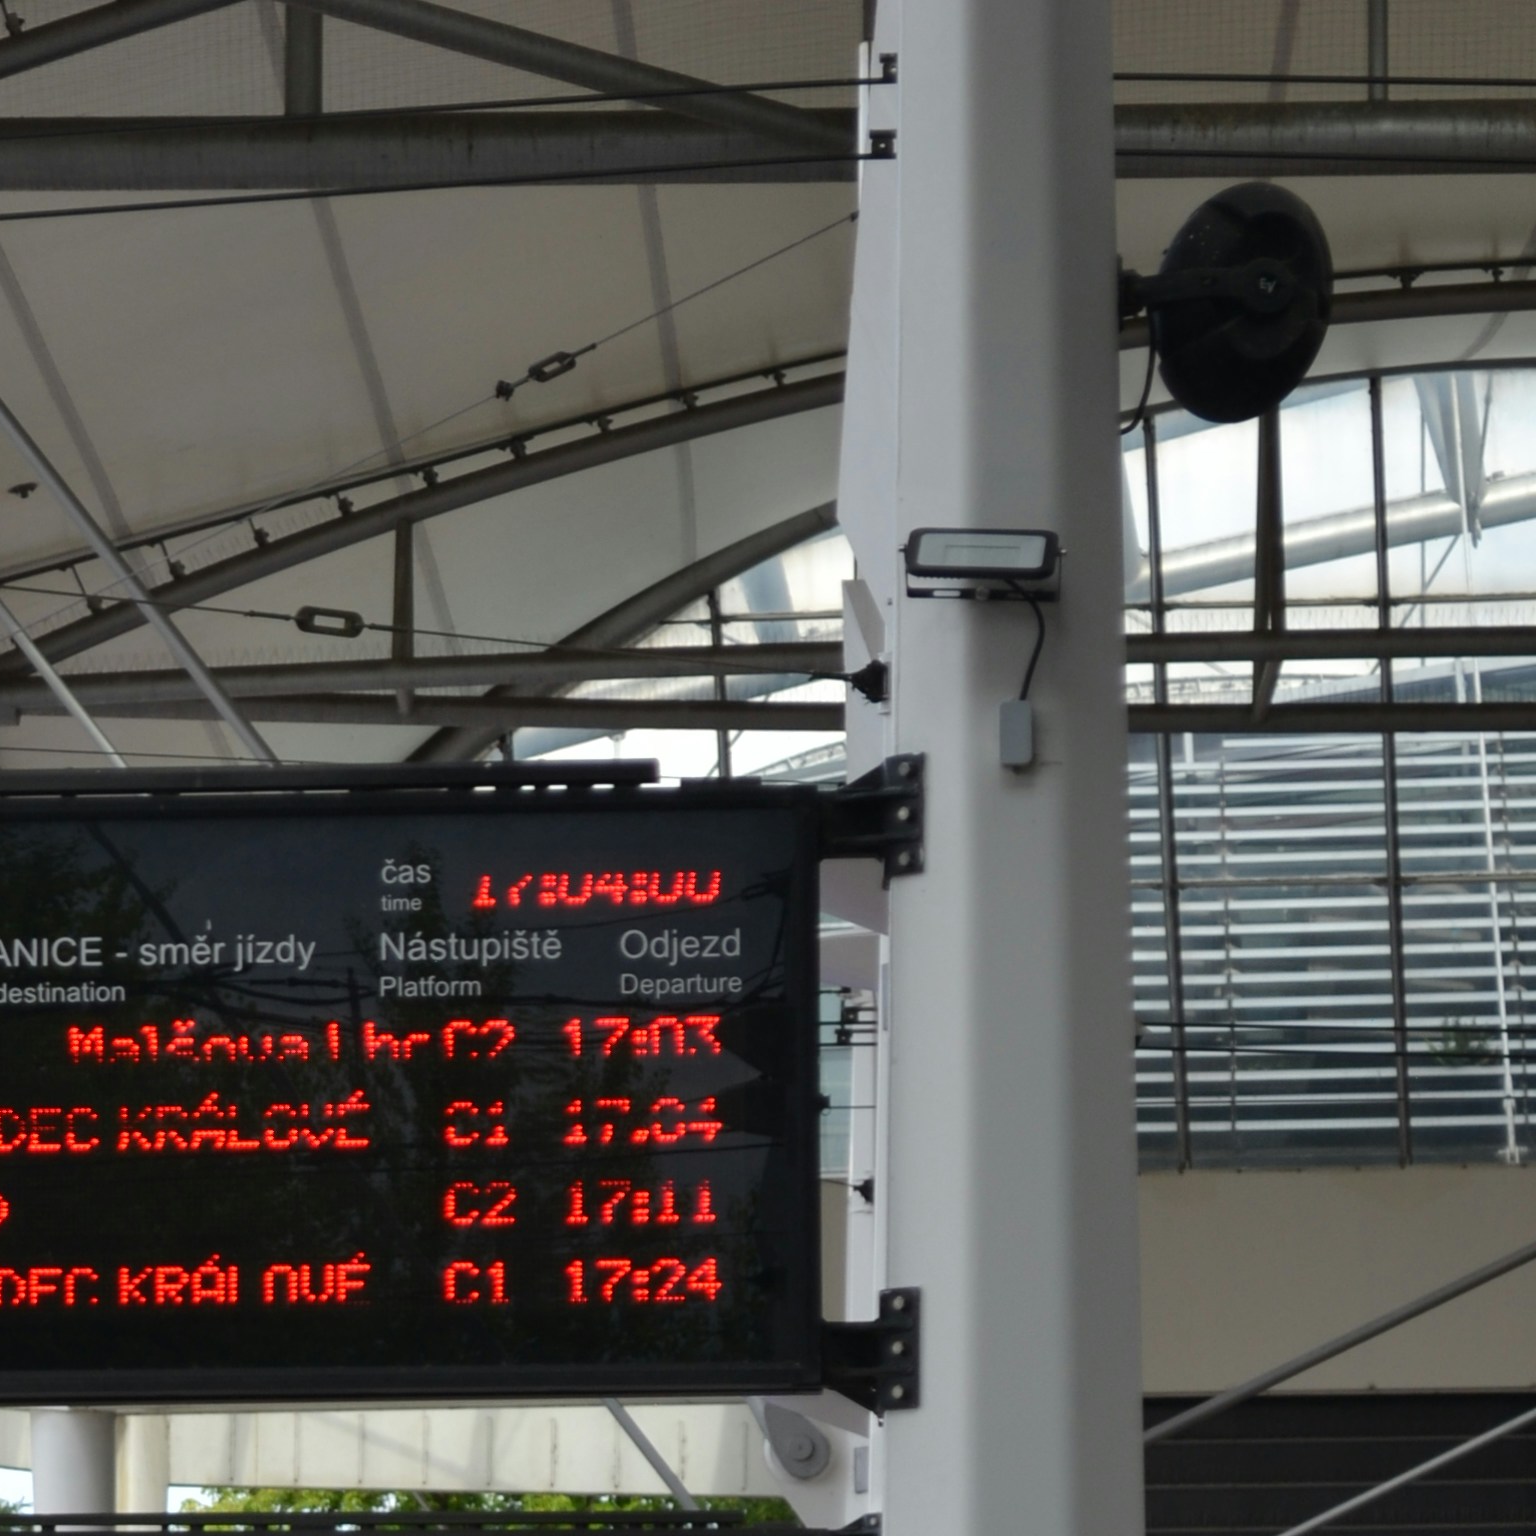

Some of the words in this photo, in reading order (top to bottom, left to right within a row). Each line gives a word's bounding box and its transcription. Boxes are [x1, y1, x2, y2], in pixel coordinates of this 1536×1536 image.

[380, 859, 432, 884] čas
[380, 894, 423, 912] time
[138, 935, 226, 966] směr
[232, 933, 316, 971] jízdy
[379, 929, 563, 967] Nástupiště
[618, 928, 742, 967] Odjezd
[378, 975, 482, 998] Platform
[618, 973, 743, 999] Departure
[444, 1101, 510, 1147] C1
[443, 1180, 517, 1226] C2
[565, 1179, 718, 1225] 17:11
[444, 1261, 510, 1303] C1
[565, 1257, 722, 1303] 17:24
